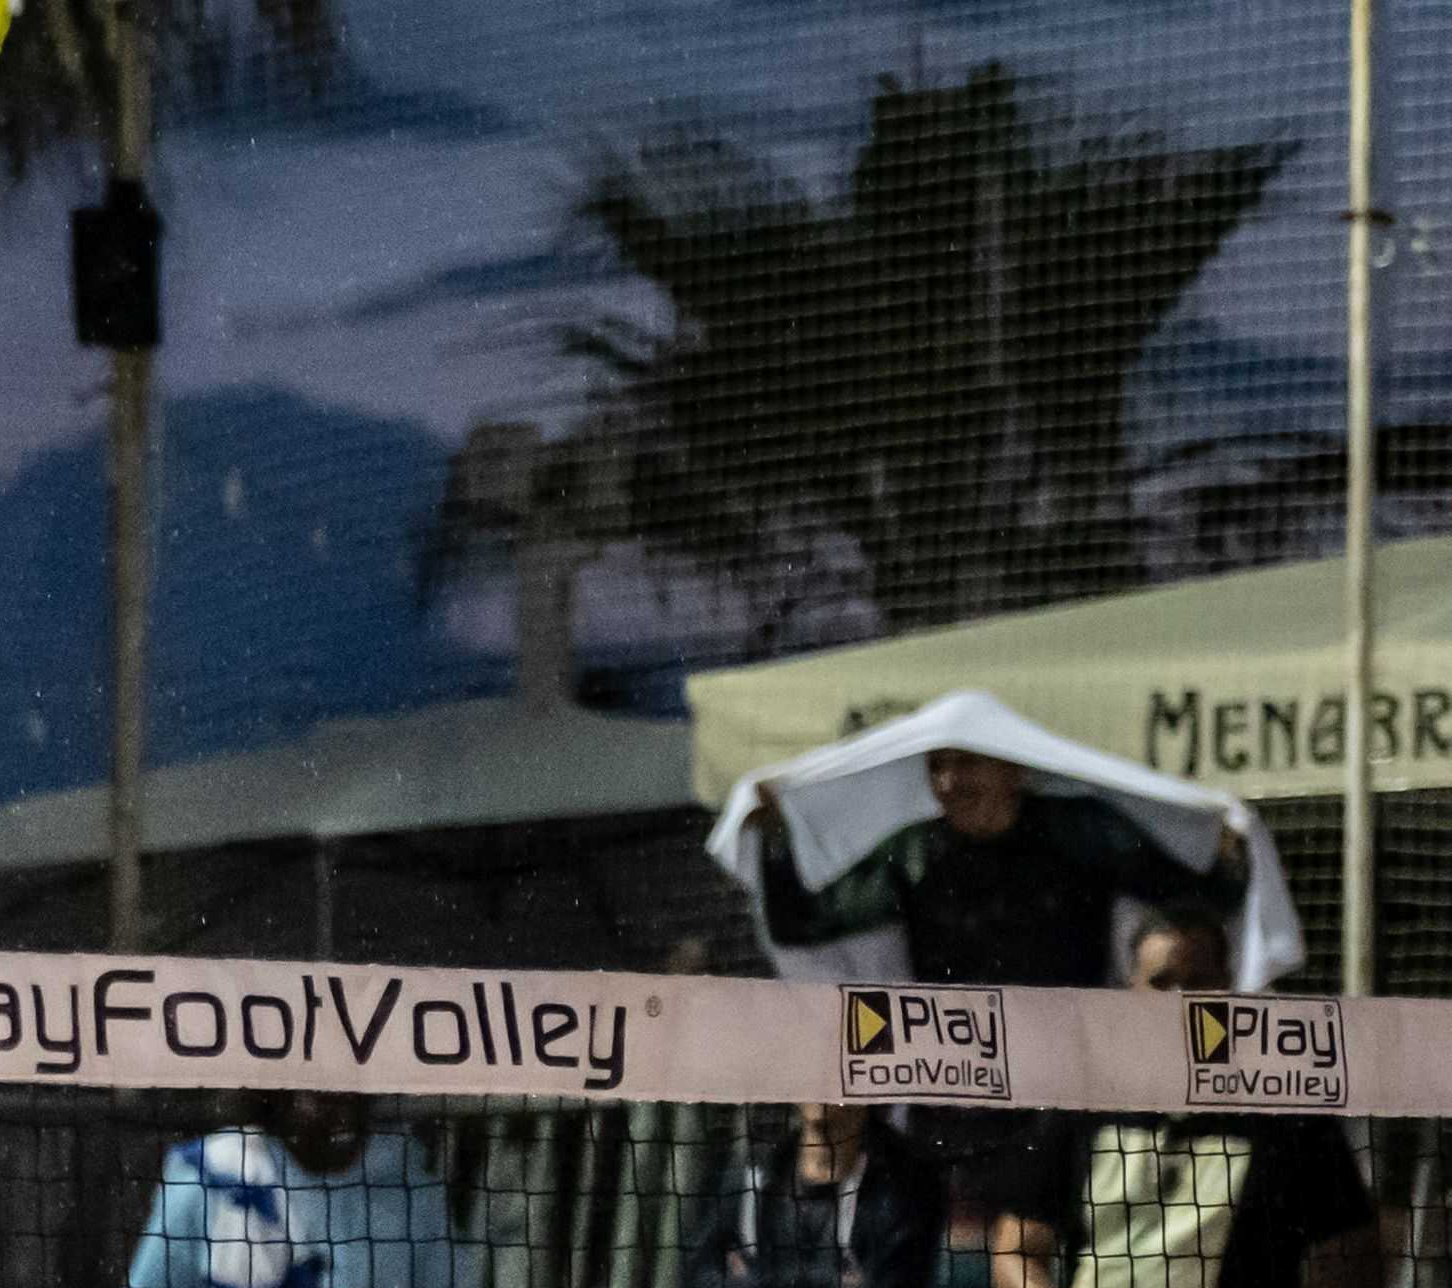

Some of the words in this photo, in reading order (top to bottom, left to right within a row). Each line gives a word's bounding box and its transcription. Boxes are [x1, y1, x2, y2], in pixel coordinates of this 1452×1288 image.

[899, 995, 998, 1060] Play
[1231, 1006, 1337, 1068] Play
[848, 1058, 1005, 1095] FootVolley
[1195, 1067, 1341, 1103] FooVolley
